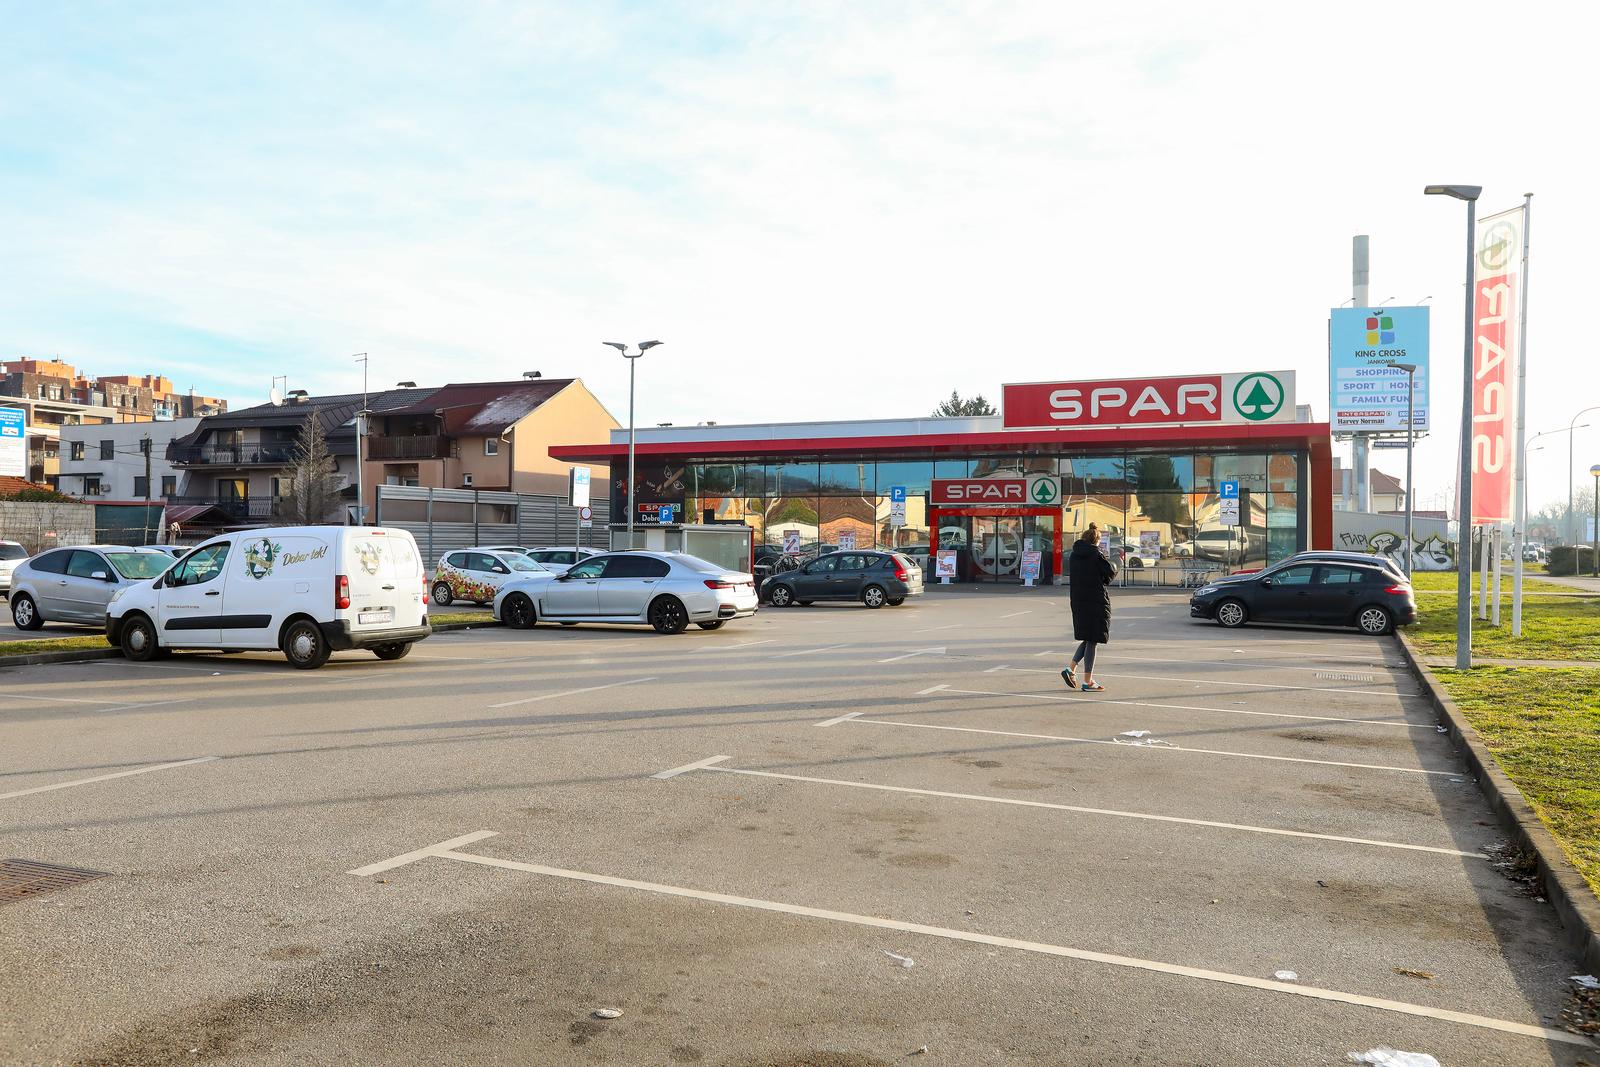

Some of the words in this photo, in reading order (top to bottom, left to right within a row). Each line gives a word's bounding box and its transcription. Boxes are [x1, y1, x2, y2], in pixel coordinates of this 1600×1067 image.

[1355, 350, 1376, 358] KING
[1379, 349, 1406, 357] CROSS
[1343, 382, 1376, 390] SPORT
[1049, 383, 1217, 420] SPAR
[1351, 396, 1388, 404] FAMILY
[894, 489, 902, 499] P
[946, 484, 1022, 499] SPAR
[1225, 484, 1234, 496] P
[662, 509, 669, 519] P
[282, 551, 309, 566] Dobar
[310, 545, 329, 560] tek!
